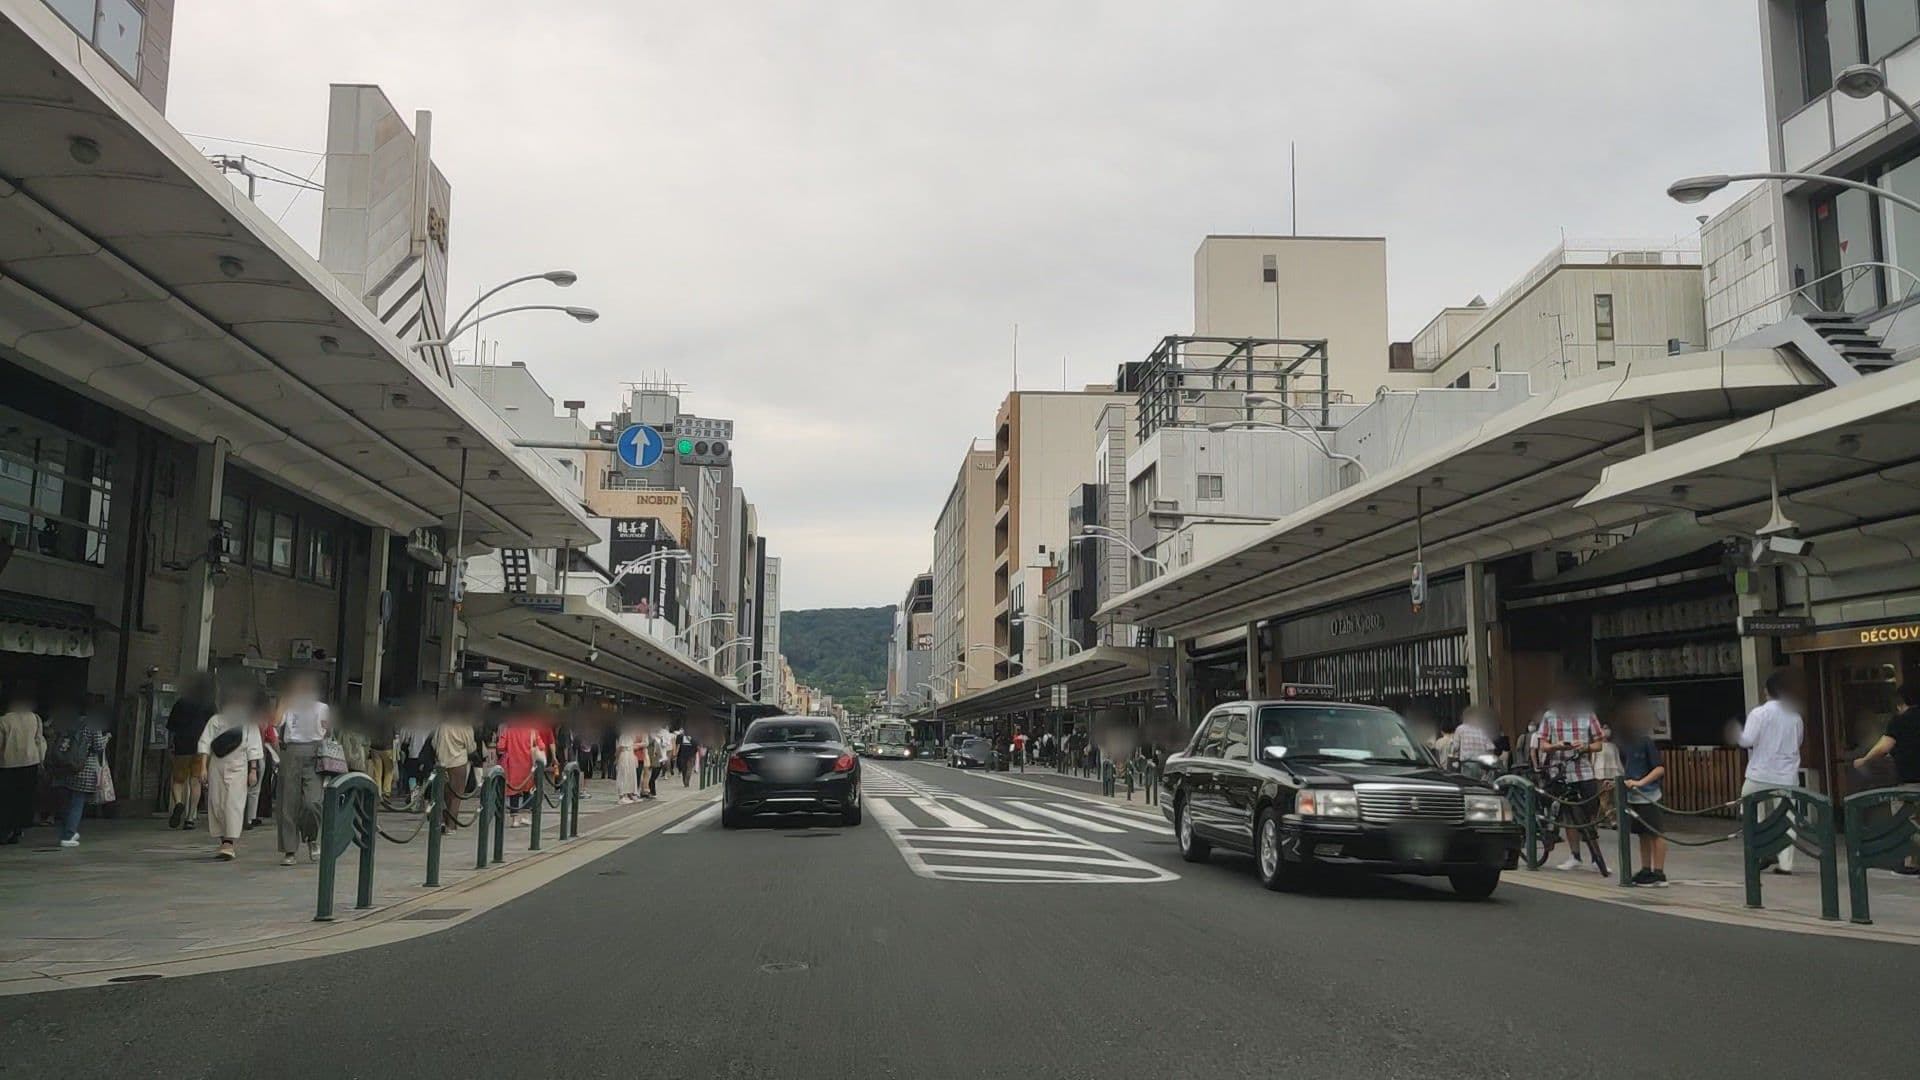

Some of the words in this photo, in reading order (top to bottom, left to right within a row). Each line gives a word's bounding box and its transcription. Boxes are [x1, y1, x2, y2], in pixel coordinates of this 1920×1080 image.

[637, 496, 678, 505] INOBUN
[614, 564, 652, 575] KAMO
[1860, 626, 1919, 643] DÉCOUV
